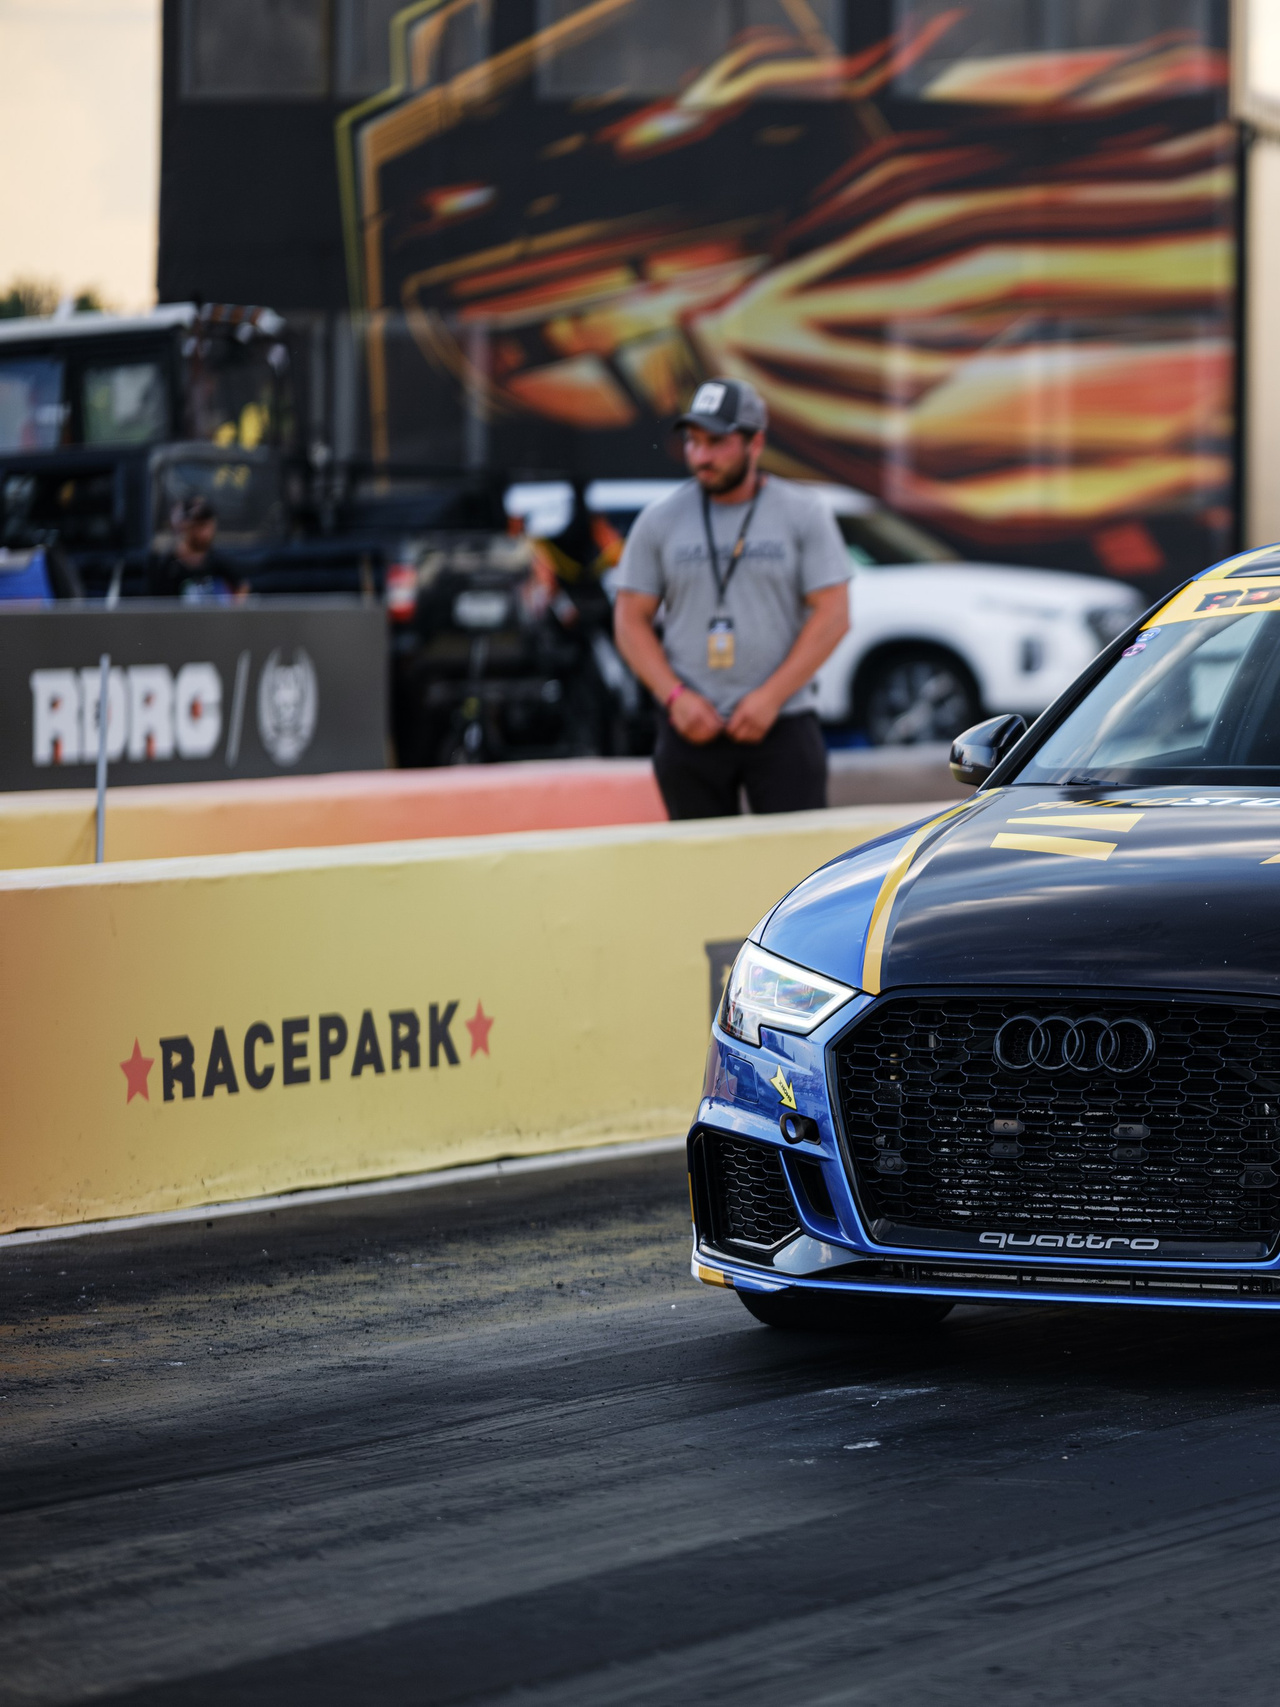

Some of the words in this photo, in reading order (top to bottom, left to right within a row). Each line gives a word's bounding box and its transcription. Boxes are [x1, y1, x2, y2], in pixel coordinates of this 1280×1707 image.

[29, 662, 222, 766] RDRC
[160, 1000, 461, 1102] RACEPARK
[979, 1232, 1159, 1250] quattro
